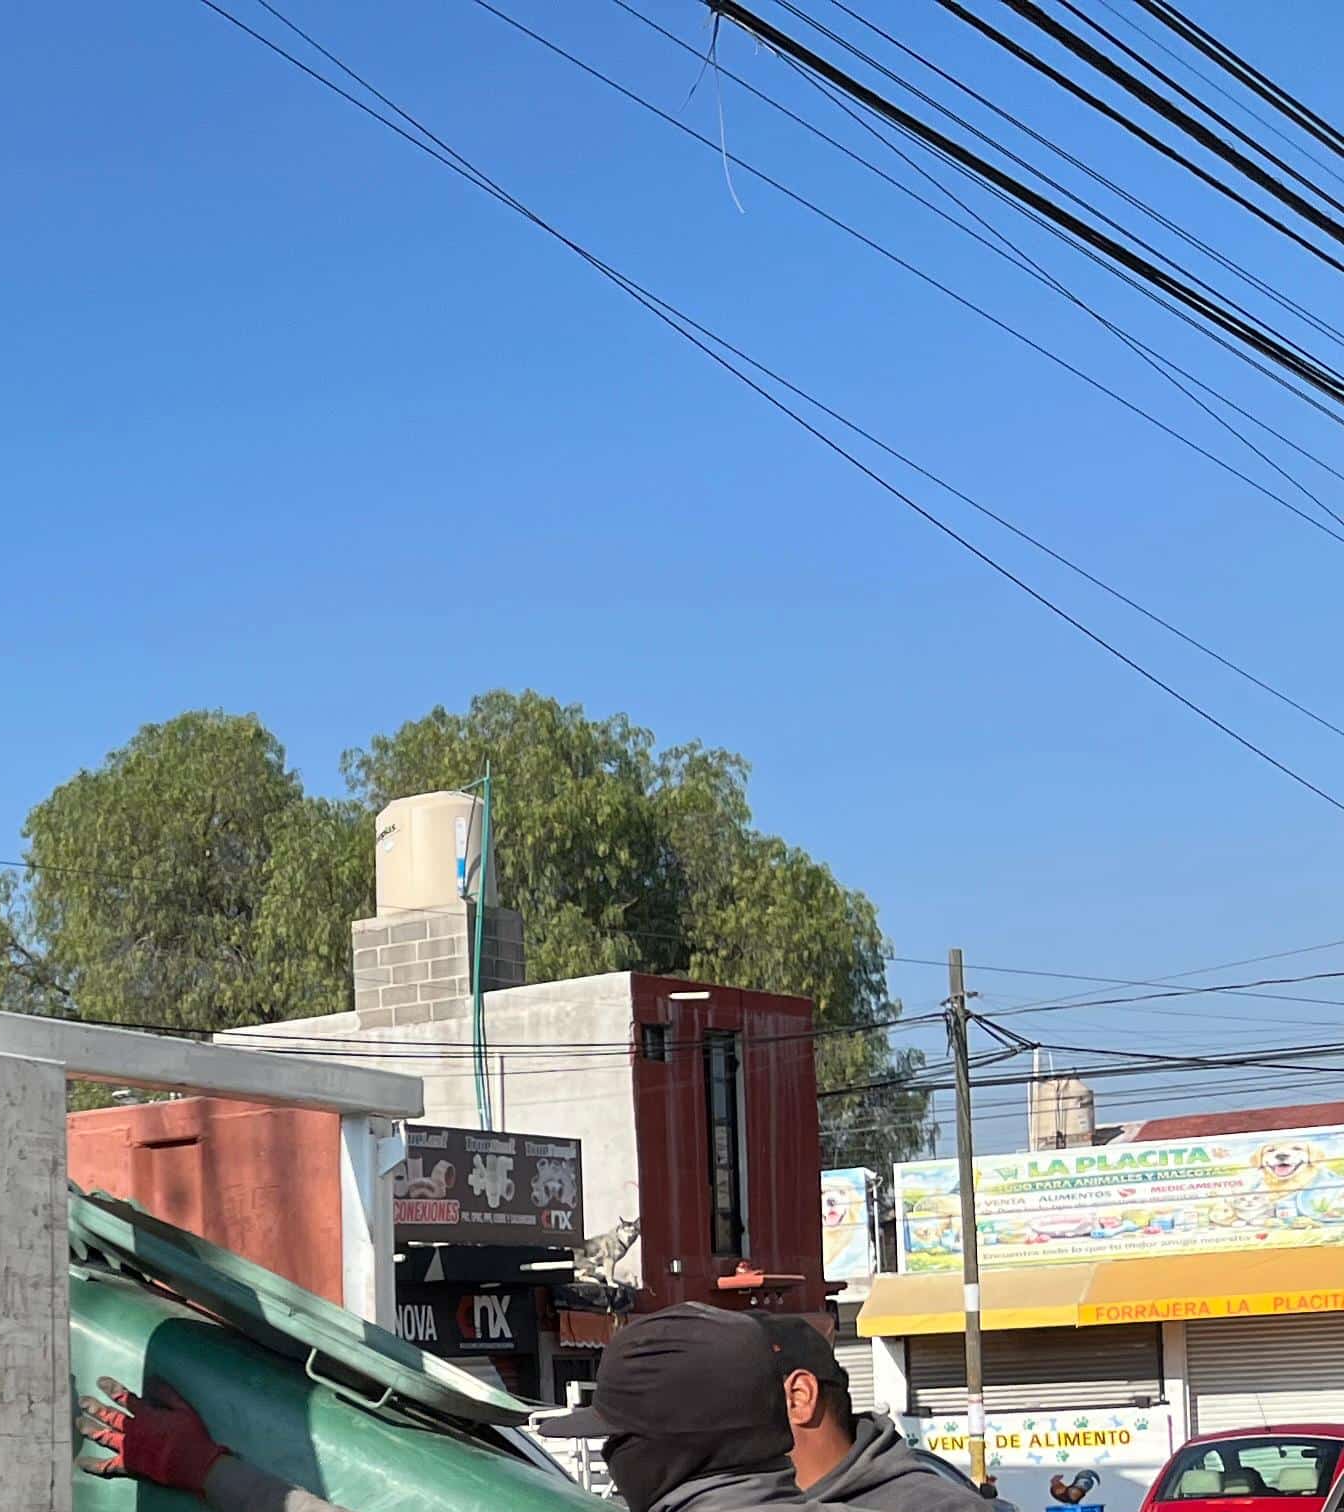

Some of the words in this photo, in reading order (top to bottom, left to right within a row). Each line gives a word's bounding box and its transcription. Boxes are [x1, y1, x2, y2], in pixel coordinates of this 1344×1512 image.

[1028, 1160, 1069, 1177] LA
[1076, 1147, 1211, 1173] PLACITA
[1039, 1190, 1112, 1203] ALIMENTOS
[1227, 1299, 1249, 1314] LA
[927, 1435, 986, 1451] VEN
[996, 1434, 1021, 1449] DE
[1030, 1430, 1131, 1449] ALIMENTO
